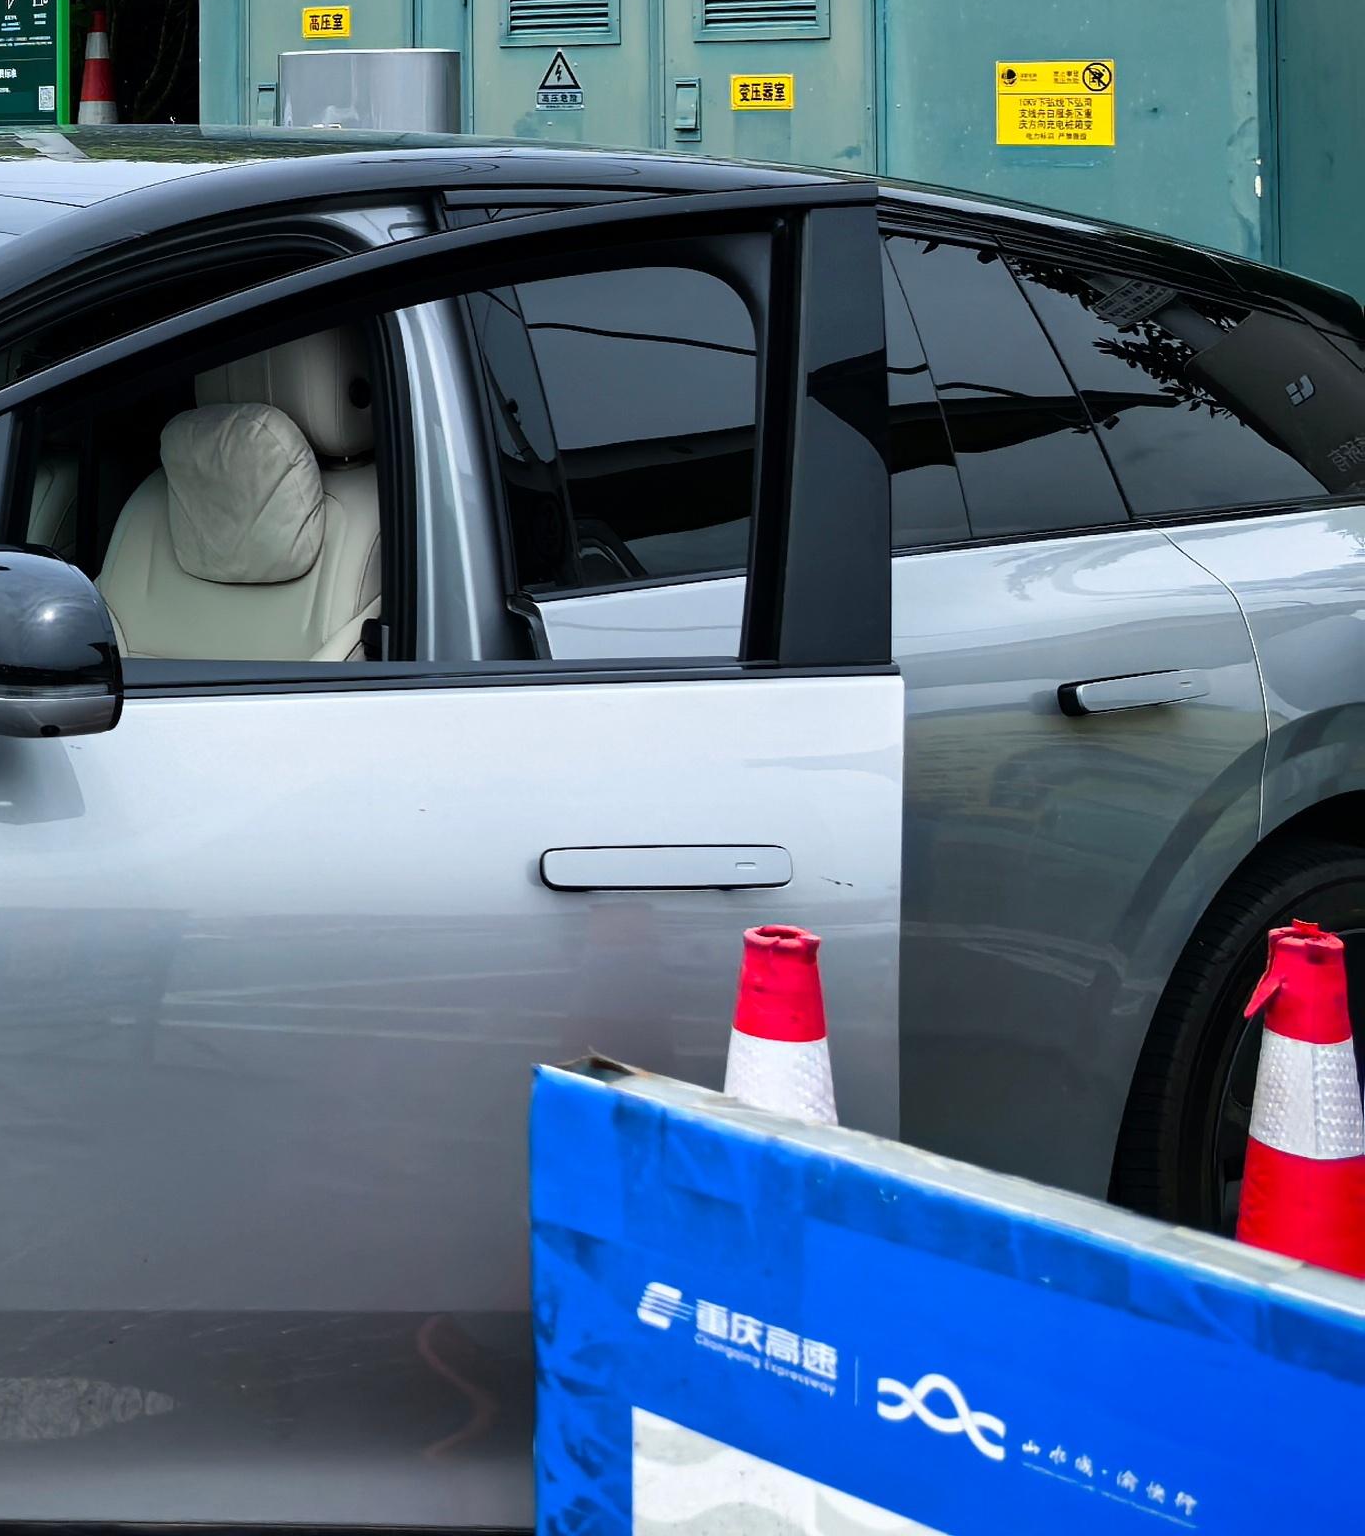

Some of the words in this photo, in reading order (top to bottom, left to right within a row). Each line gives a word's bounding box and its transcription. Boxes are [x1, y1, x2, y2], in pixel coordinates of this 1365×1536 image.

[309, 13, 344, 31] 高压室
[739, 82, 786, 102] 变压器室
[696, 1298, 837, 1380] 重庆高速
